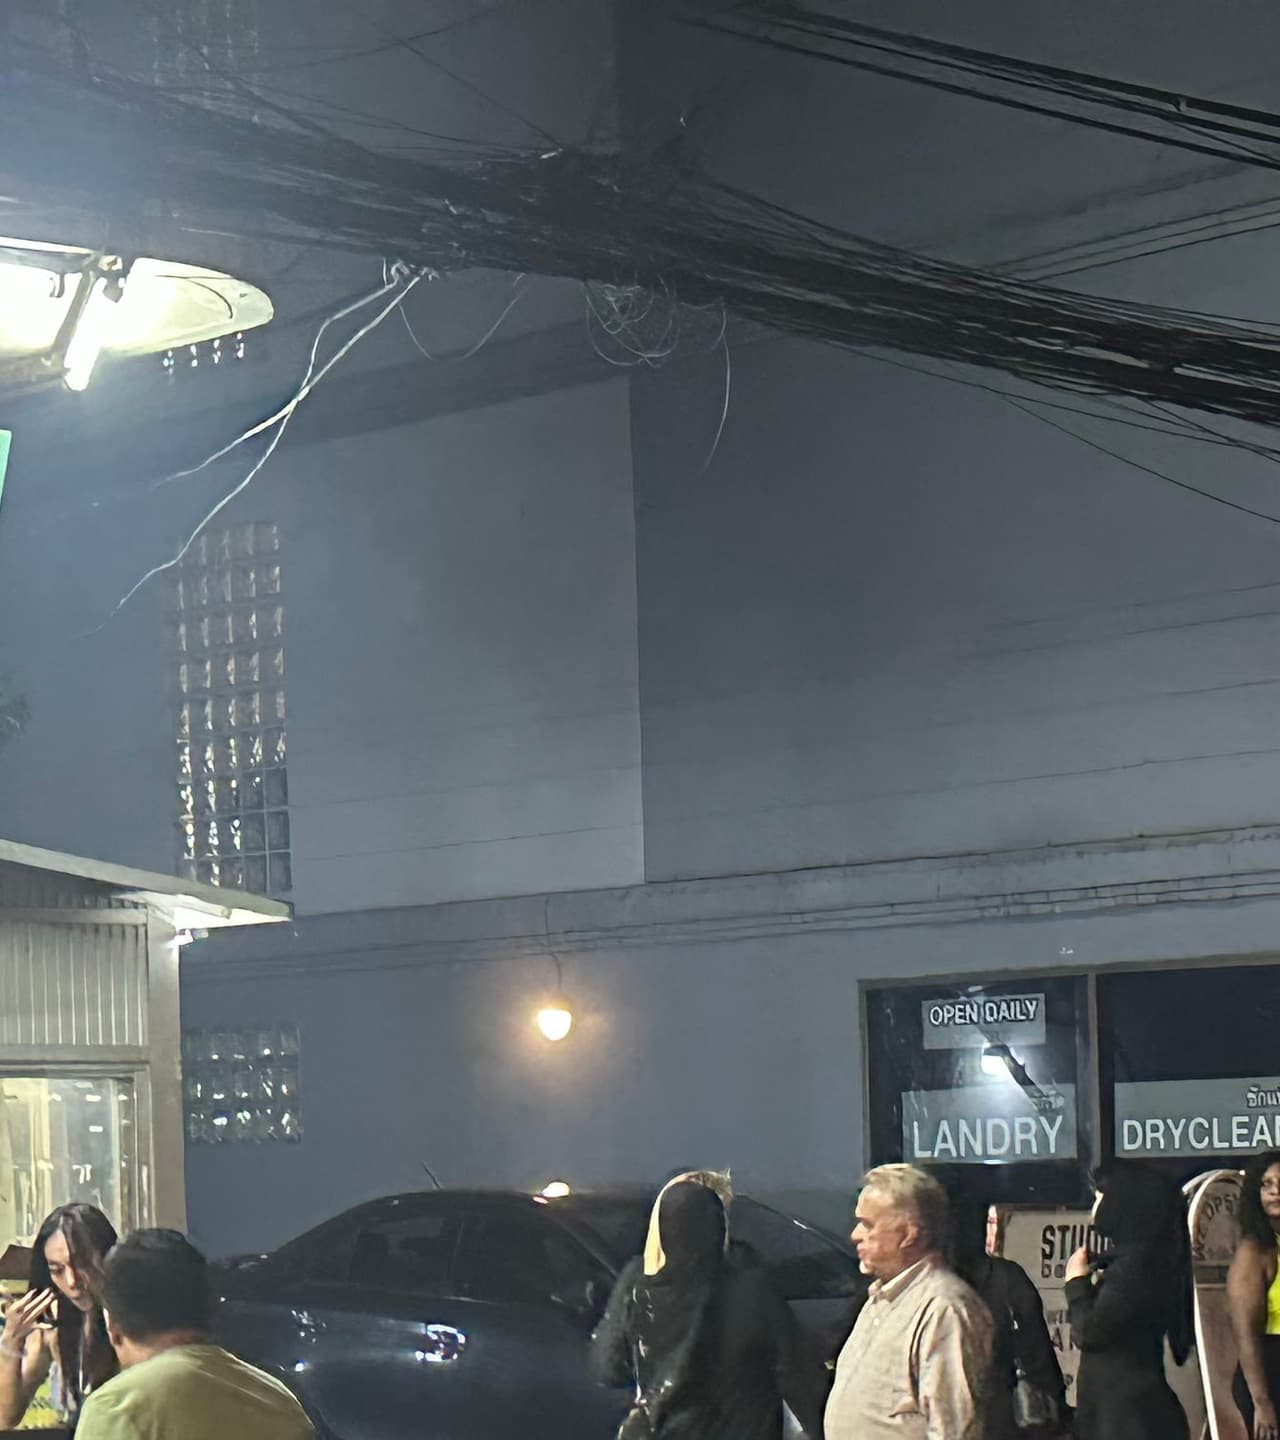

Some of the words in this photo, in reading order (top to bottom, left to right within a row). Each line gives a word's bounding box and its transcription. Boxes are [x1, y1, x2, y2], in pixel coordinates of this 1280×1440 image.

[929, 1002, 979, 1026] OPEN
[984, 999, 1038, 1024] DAILY
[912, 1114, 1064, 1159] LANDRY
